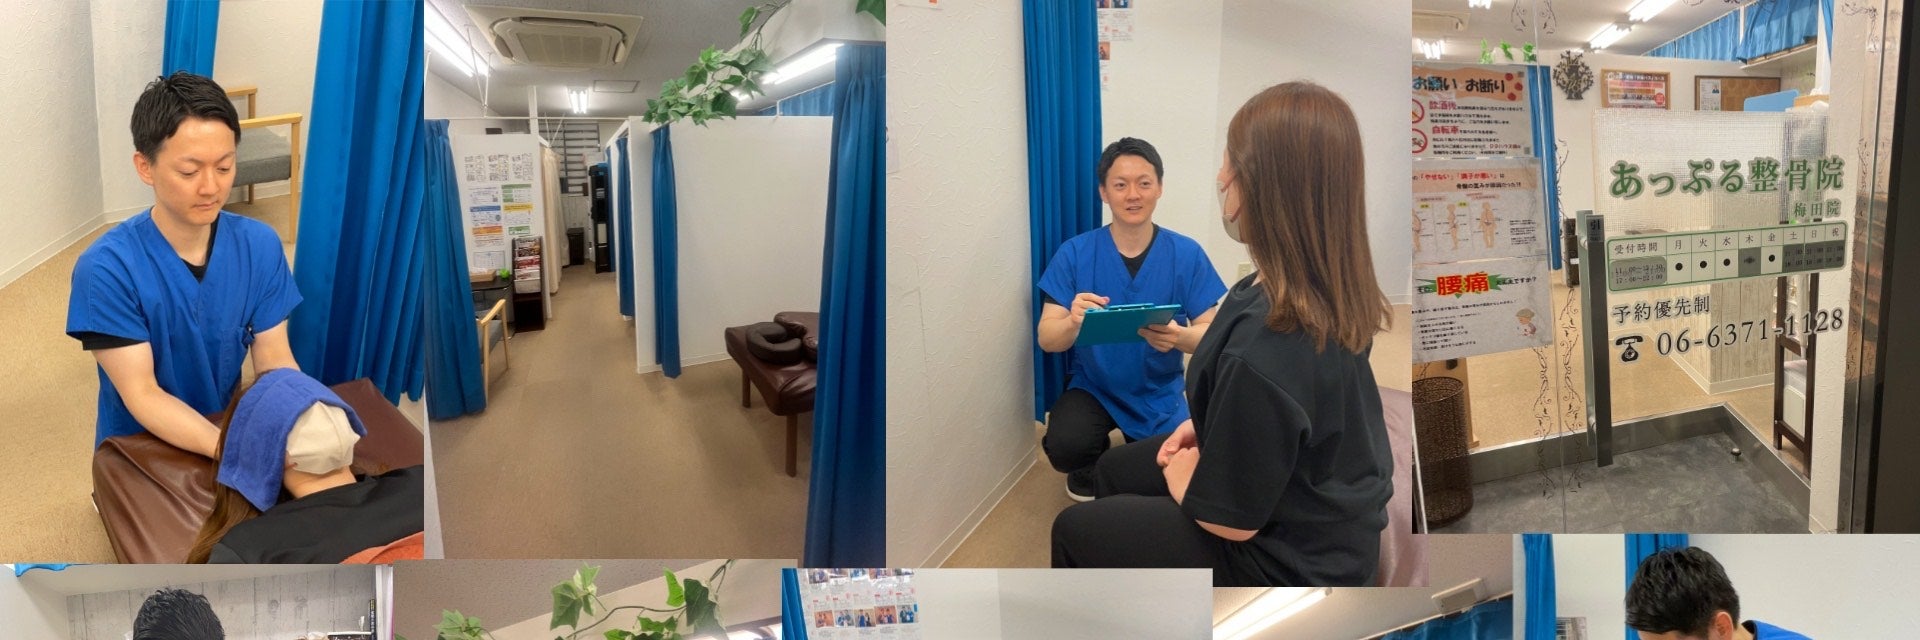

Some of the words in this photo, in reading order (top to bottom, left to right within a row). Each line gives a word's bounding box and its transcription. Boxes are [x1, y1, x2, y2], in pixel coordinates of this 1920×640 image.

[1412, 76, 1457, 91] お願い
[1465, 79, 1505, 93] お断り
[1610, 156, 1845, 199] あっぷる整骨院
[1793, 200, 1841, 218] 梅田院
[1614, 242, 1658, 254] 受付時間
[1674, 240, 1682, 250] 月
[1699, 238, 1708, 248] 火
[1722, 236, 1731, 246] 水
[1745, 234, 1754, 244] 木
[1767, 232, 1776, 242] 金
[1789, 231, 1799, 240] 土
[1810, 229, 1817, 239] 日
[1832, 227, 1840, 237] 祝
[1436, 272, 1489, 296] 腰痛
[1612, 296, 1710, 324] 予約優先制
[1657, 309, 1843, 356] 06-6371-1128
